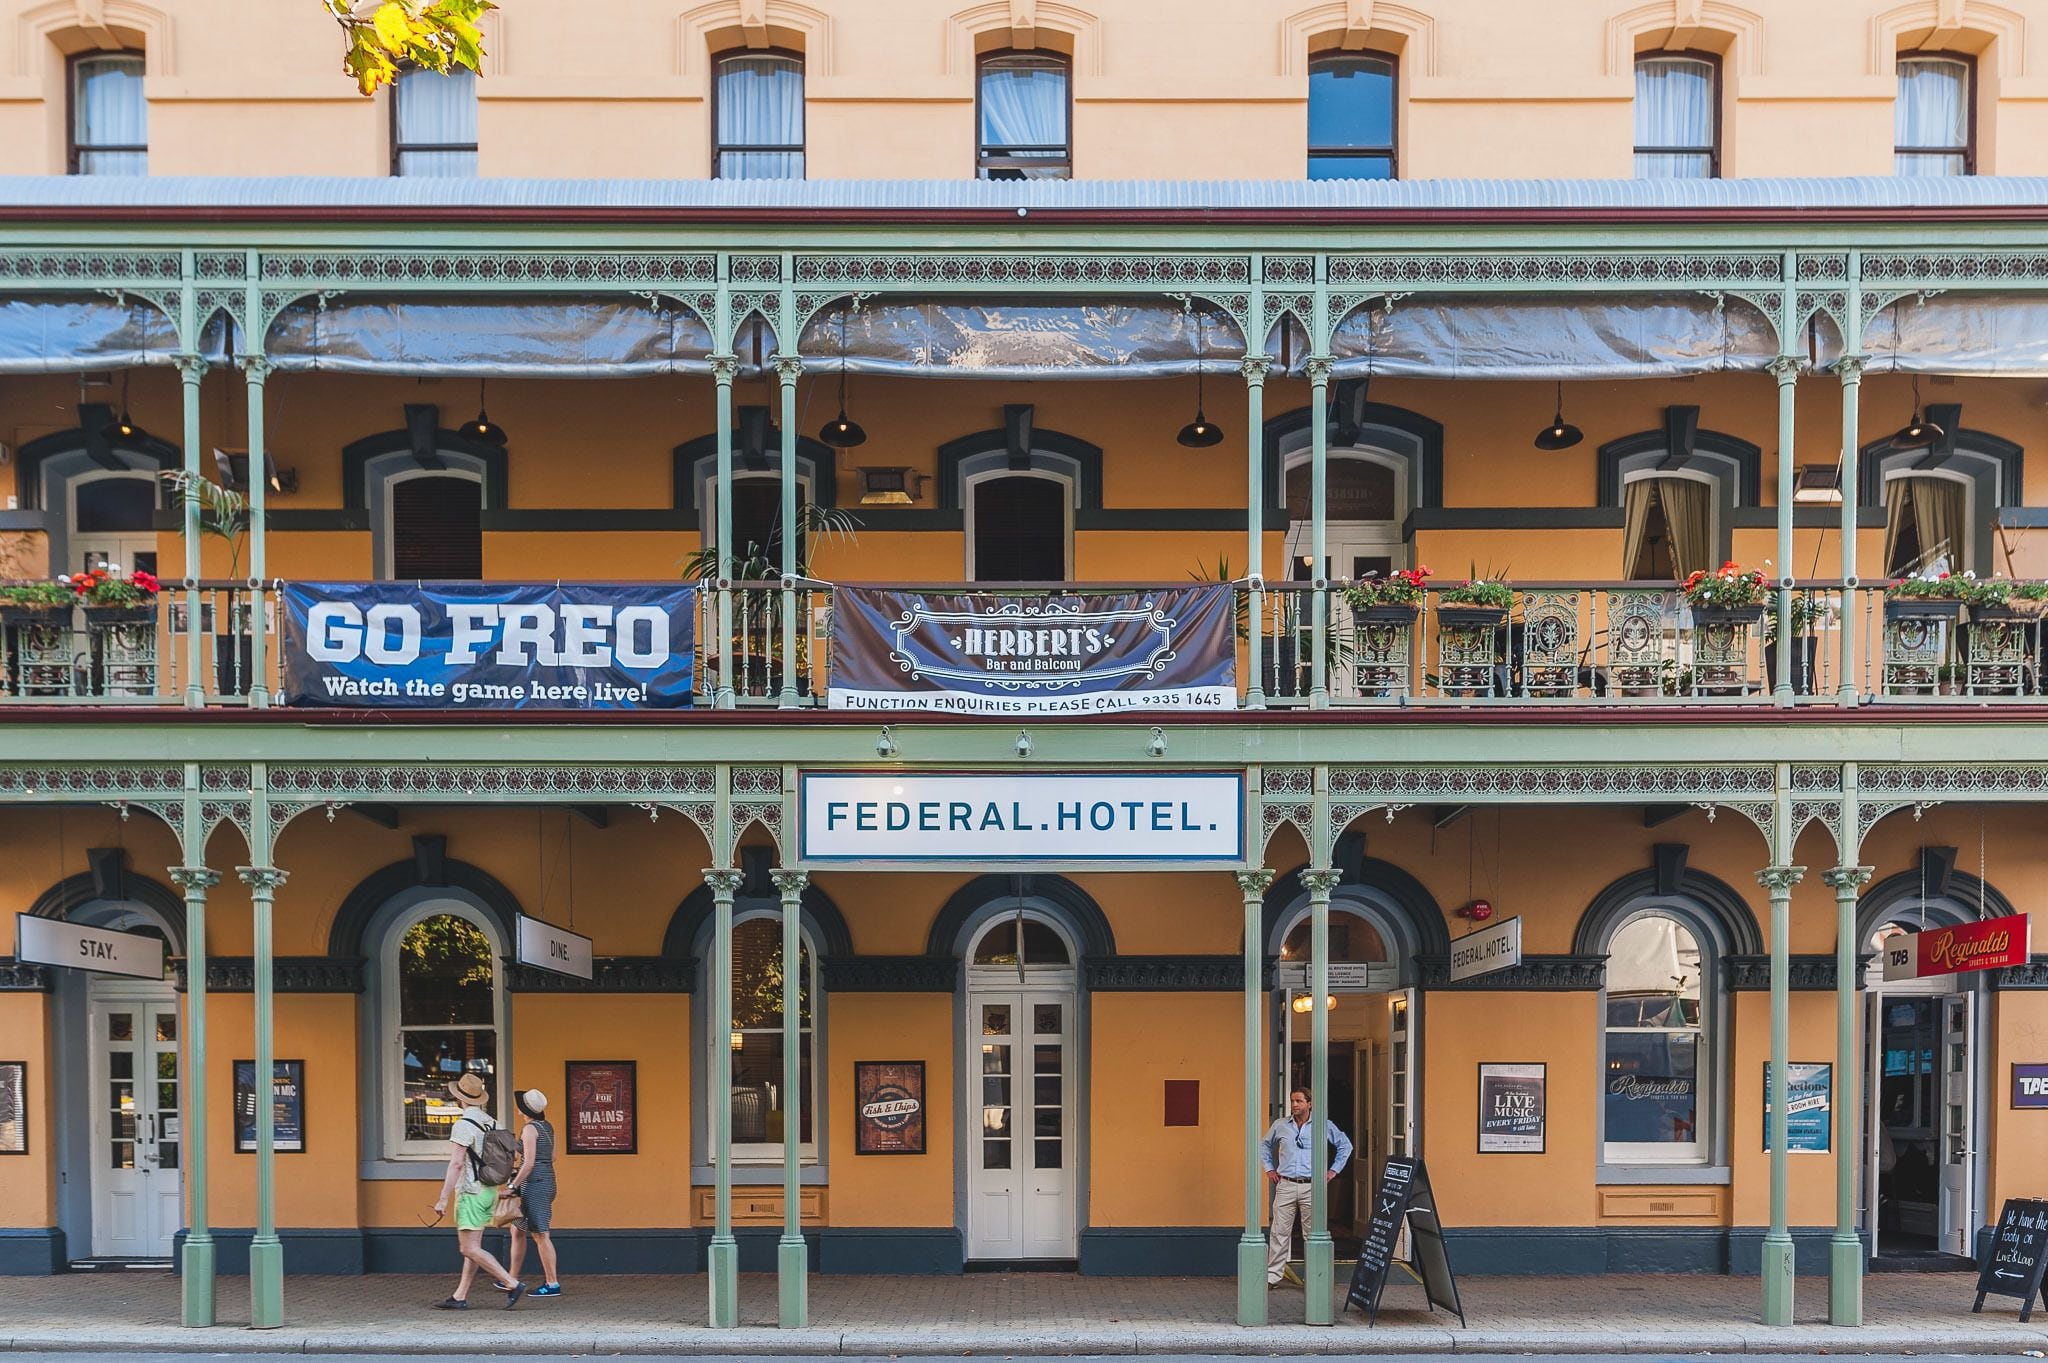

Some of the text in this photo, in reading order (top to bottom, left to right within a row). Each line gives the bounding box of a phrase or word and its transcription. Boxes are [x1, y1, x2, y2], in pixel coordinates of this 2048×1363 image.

[307, 602, 670, 669] GO FREO
[964, 625, 1102, 657] HERBERT'S
[986, 658, 1081, 672] Bar and Balcony
[323, 676, 648, 703] Watch the game here live!
[846, 693, 1222, 712] FUNCTION ENQUIRIES PLEASE CALL 9335 1645
[79, 939, 118, 962] STAY.
[550, 939, 570, 963] DINE.
[1890, 949, 1909, 966] TAB
[1931, 930, 2010, 969] Reginald's
[281, 1085, 296, 1096] MIC
[579, 1080, 598, 1111] 2
[596, 1094, 613, 1102] FOR
[1610, 1074, 1690, 1100] Reginald's
[865, 1102, 917, 1115] Fish & Chips
[1494, 1095, 1536, 1108] LIVE
[1791, 1102, 1806, 1111] ROOM
[579, 1110, 624, 1123] MAINS
[1494, 1108, 1534, 1117] MUSIC
[1486, 1116, 1541, 1128] EVERY FRIDAY
[2006, 1210, 2048, 1231] We have the
[2023, 1234, 2033, 1245] on
